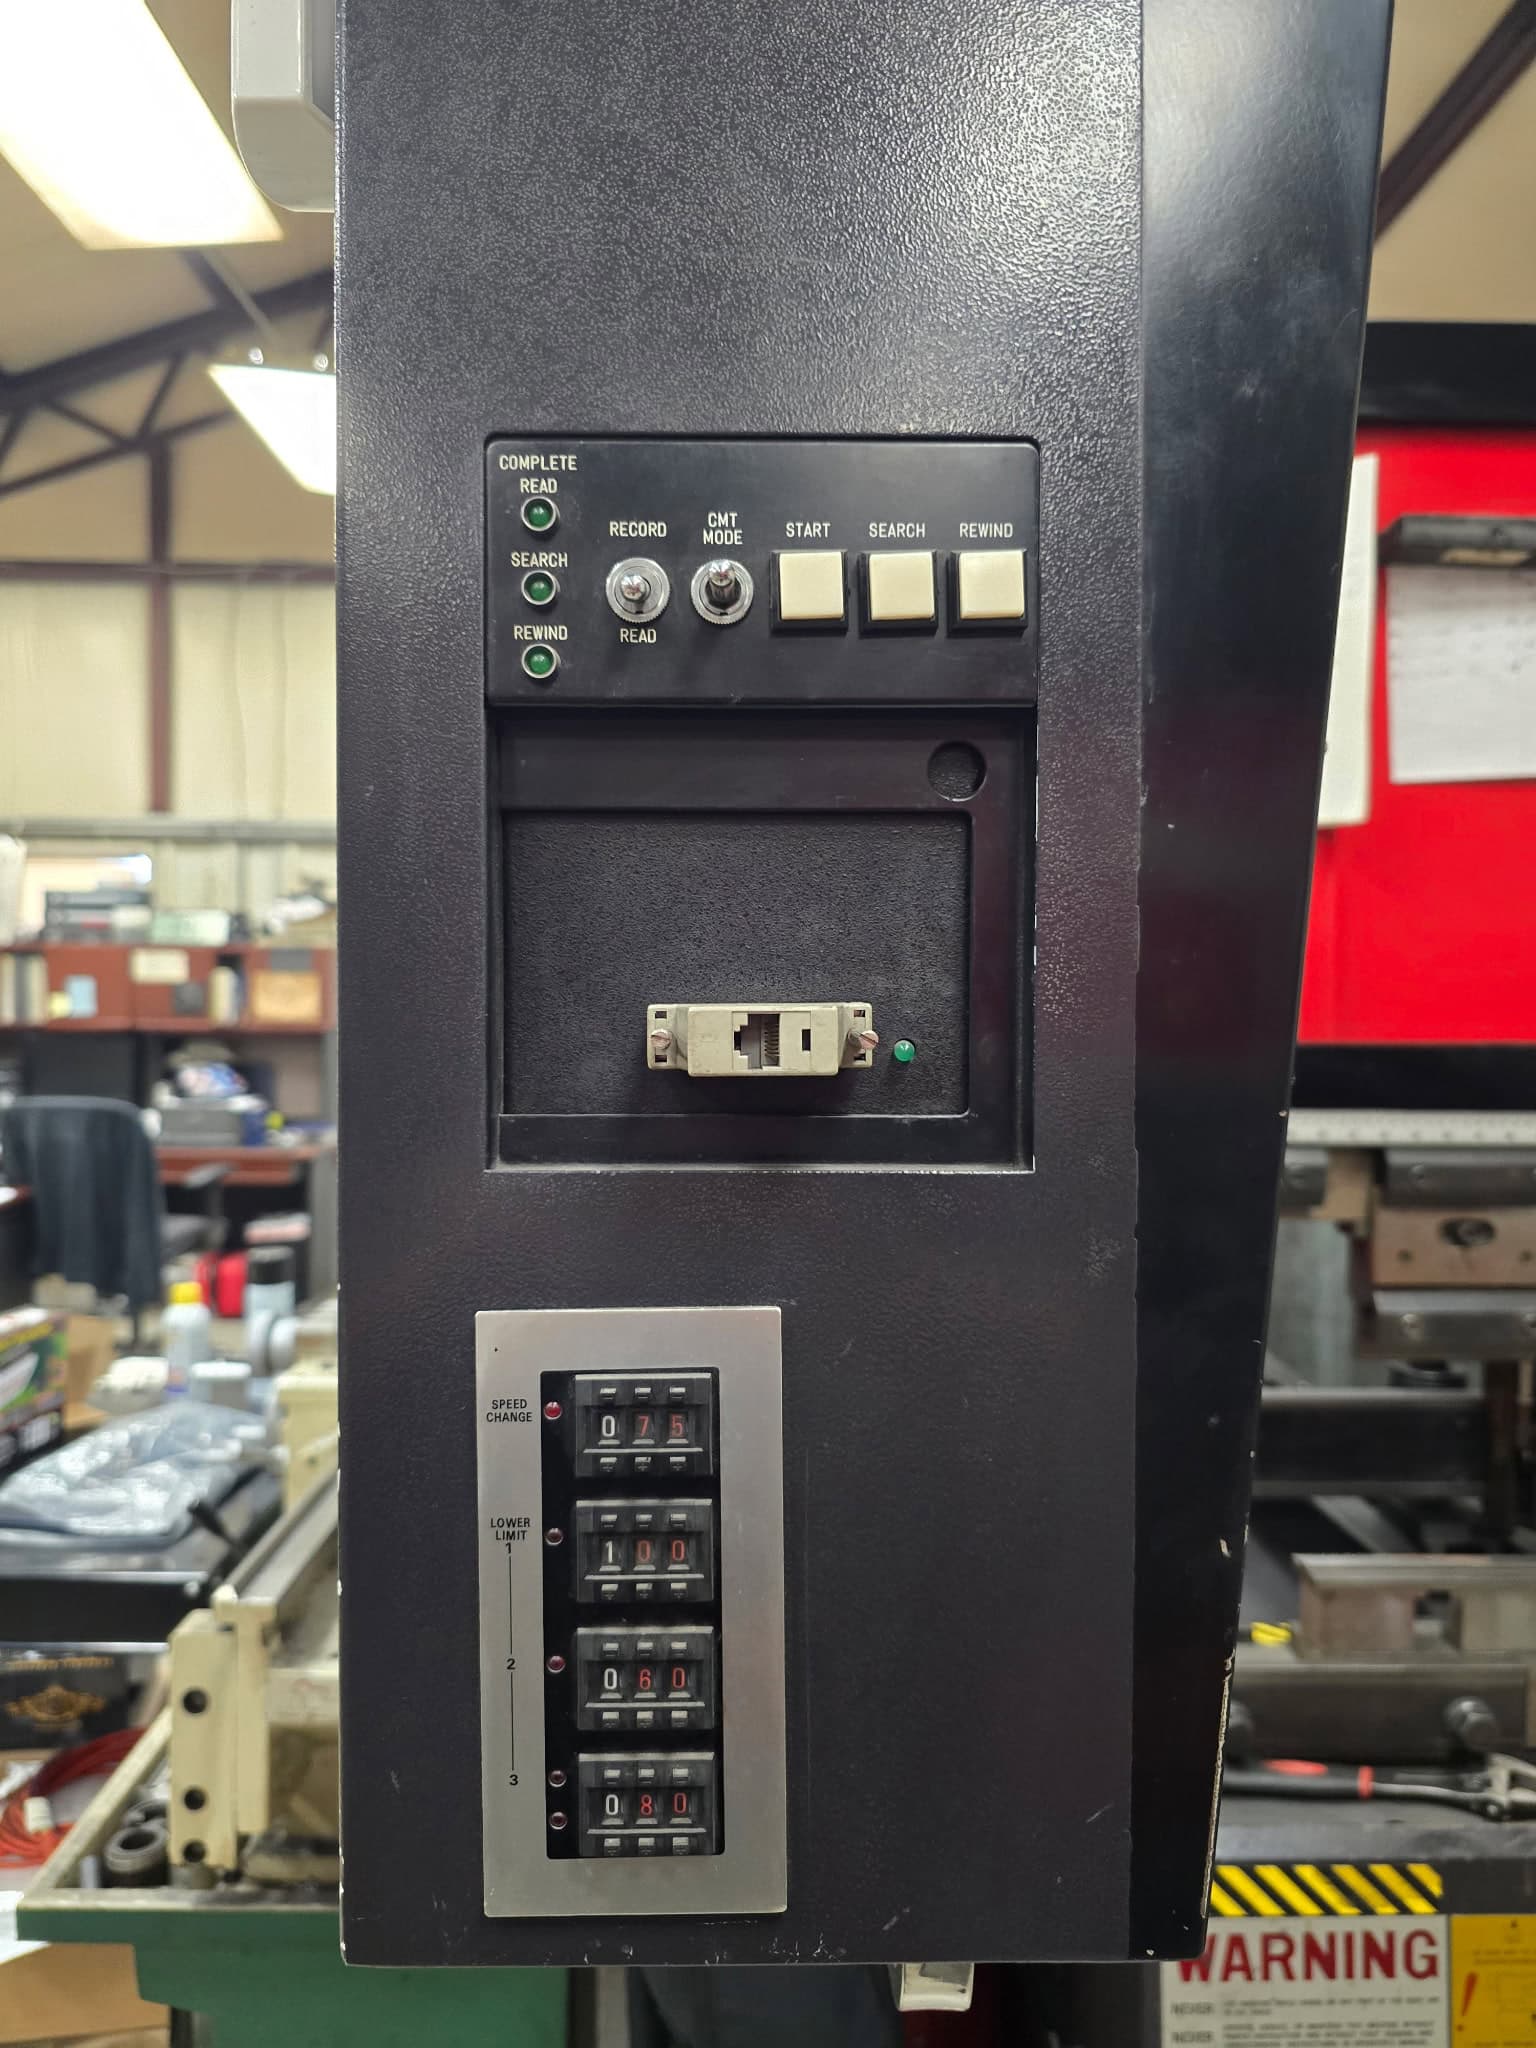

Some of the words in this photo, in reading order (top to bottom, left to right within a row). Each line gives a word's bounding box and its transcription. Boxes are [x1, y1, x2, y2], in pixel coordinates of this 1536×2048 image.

[499, 454, 577, 471] COMPLETE
[519, 478, 558, 494] READ
[707, 511, 738, 528] CMT
[609, 521, 667, 538] RECORD
[703, 529, 743, 545] MODE
[785, 522, 831, 538] START
[869, 522, 926, 538] SEARCH
[959, 522, 1013, 538] REWIND
[511, 551, 568, 568] SEARCH
[513, 625, 568, 641] REWIND
[620, 628, 657, 644] READ
[491, 1398, 528, 1410] SPEED
[486, 1411, 533, 1423] CHANGE
[490, 1517, 531, 1529] LOWER
[495, 1530, 528, 1541] LIMIT
[505, 1543, 512, 1555] 1
[506, 1658, 516, 1671] 2
[509, 1774, 519, 1787] 3
[1178, 1930, 1439, 1982] WARNING
